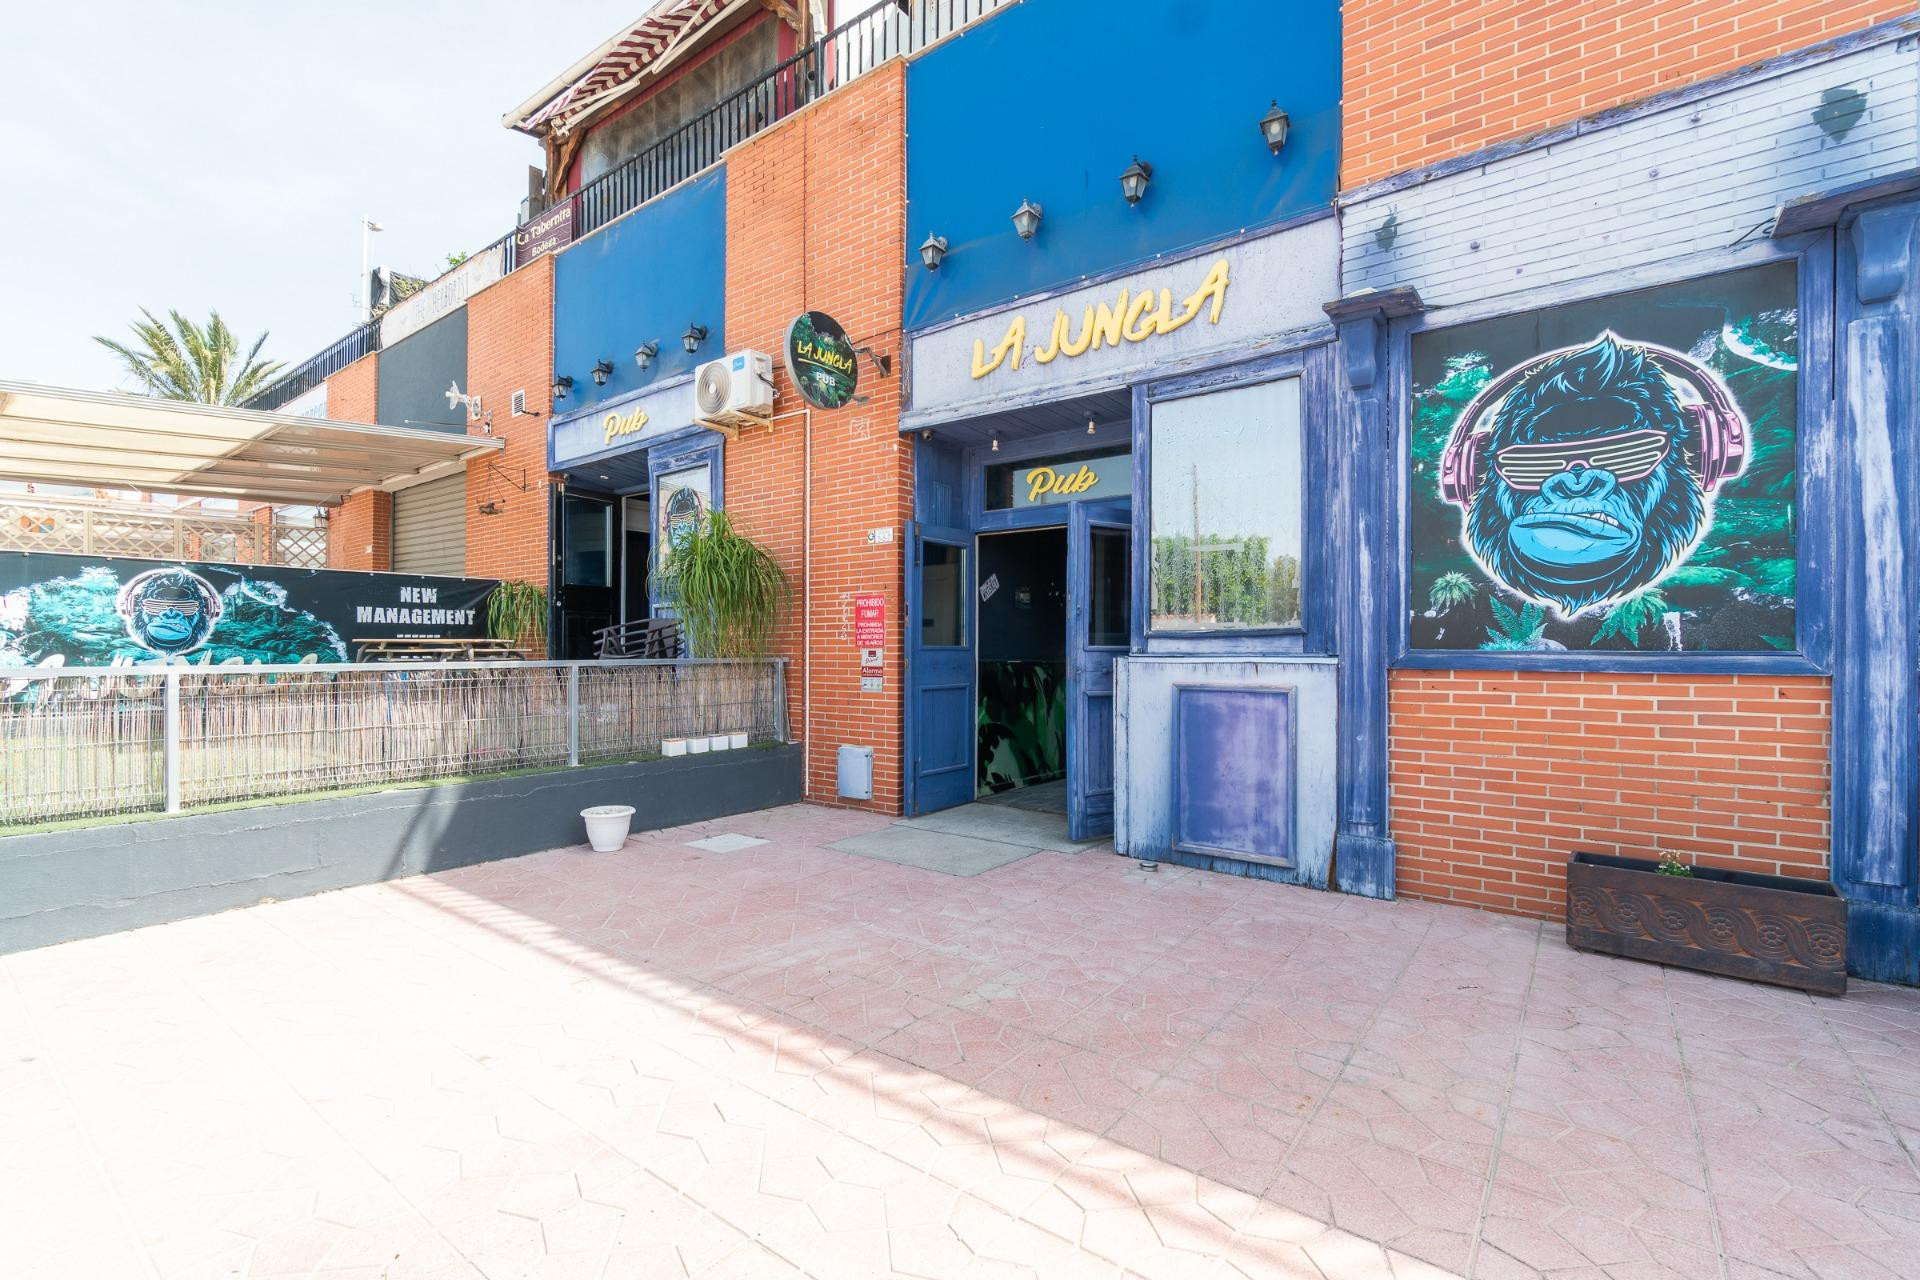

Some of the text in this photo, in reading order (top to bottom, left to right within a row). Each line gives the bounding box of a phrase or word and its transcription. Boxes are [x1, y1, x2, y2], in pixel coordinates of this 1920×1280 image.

[517, 206, 571, 246] La Tabernita
[971, 258, 1230, 380] LA JUNGLA
[797, 340, 853, 374] LA JUNGLA
[816, 371, 836, 387] PUB
[603, 406, 649, 446] Pub
[1026, 464, 1099, 502] Pub
[400, 586, 438, 604] NEW
[856, 598, 884, 607] PROHIBIDO
[356, 606, 476, 625] MANAGEMENT
[861, 609, 879, 618] FUMAR
